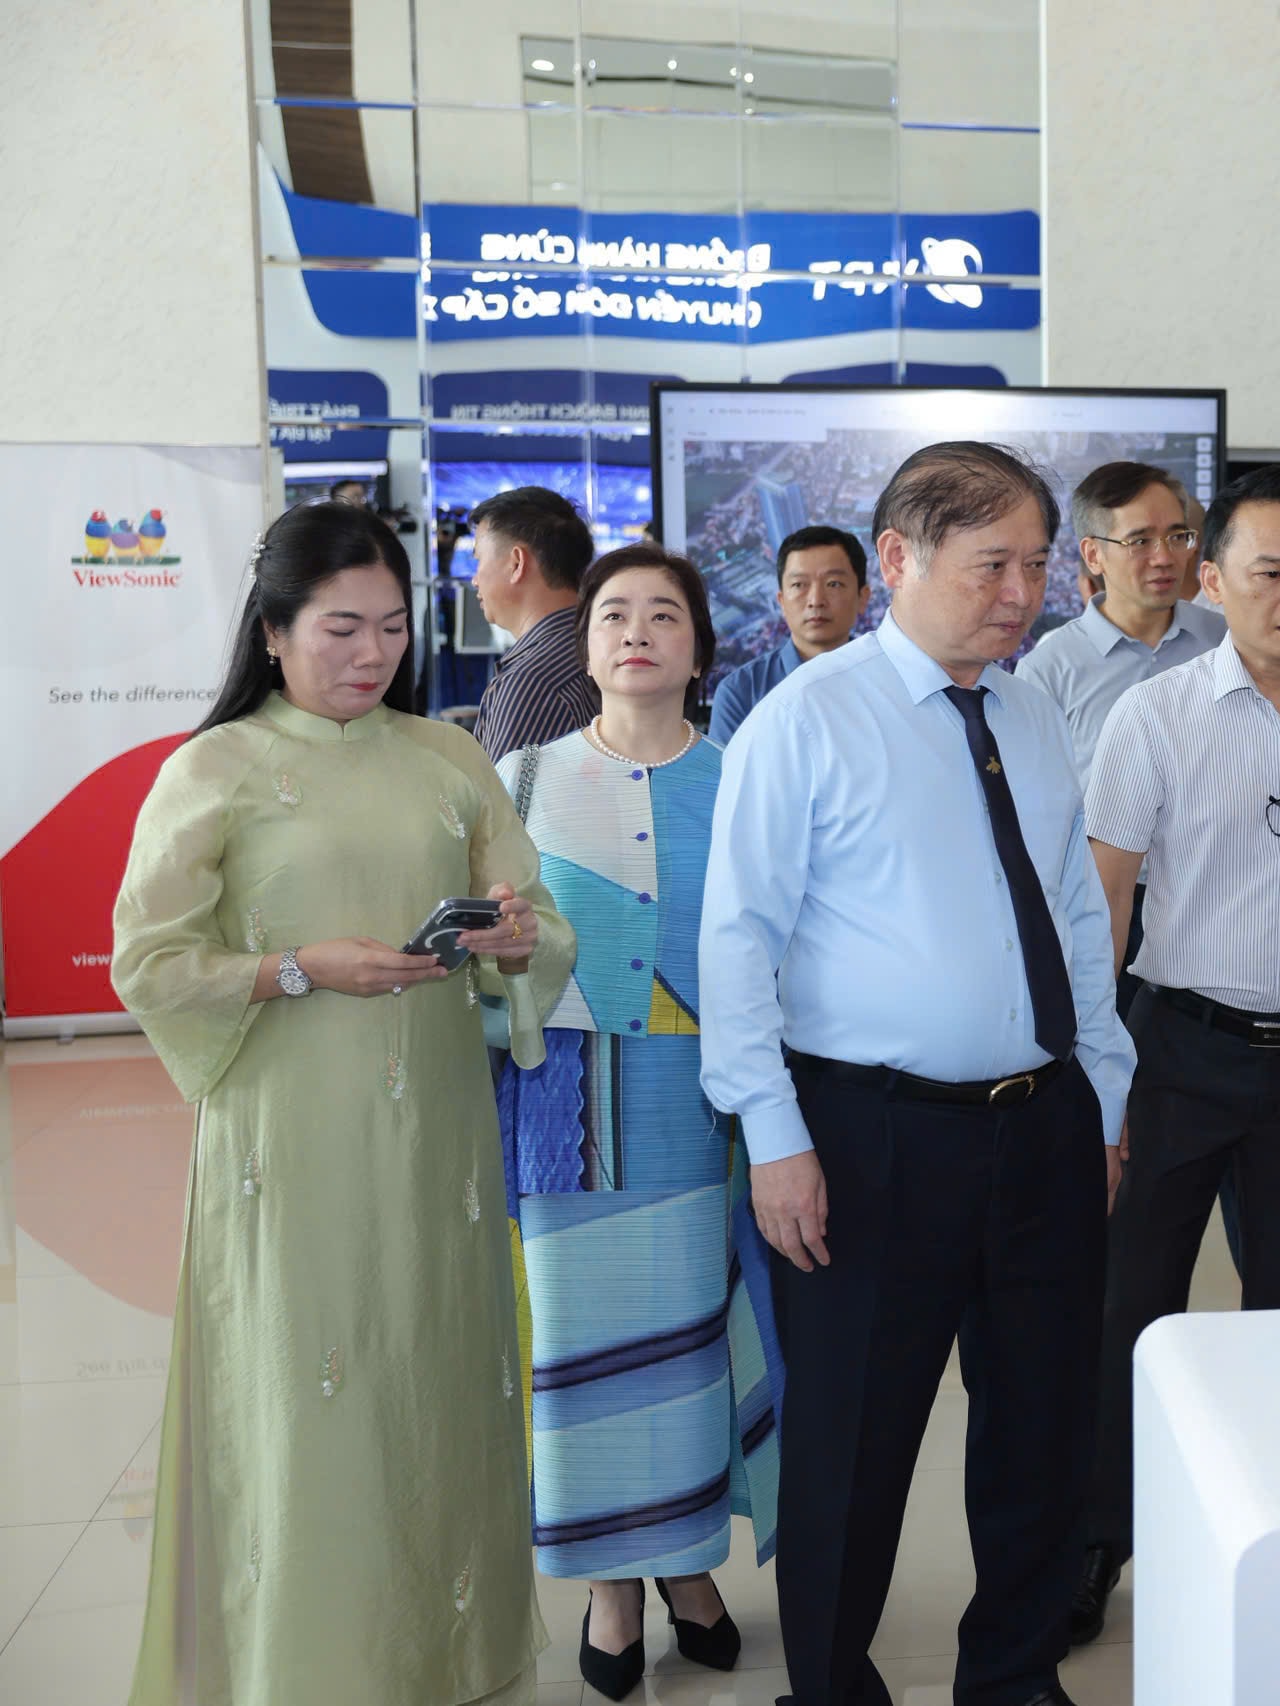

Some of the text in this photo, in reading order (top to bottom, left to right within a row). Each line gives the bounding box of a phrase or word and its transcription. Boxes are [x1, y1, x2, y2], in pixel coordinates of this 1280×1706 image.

[73, 568, 178, 587] ViewSonic
[49, 684, 218, 704] See the difference
